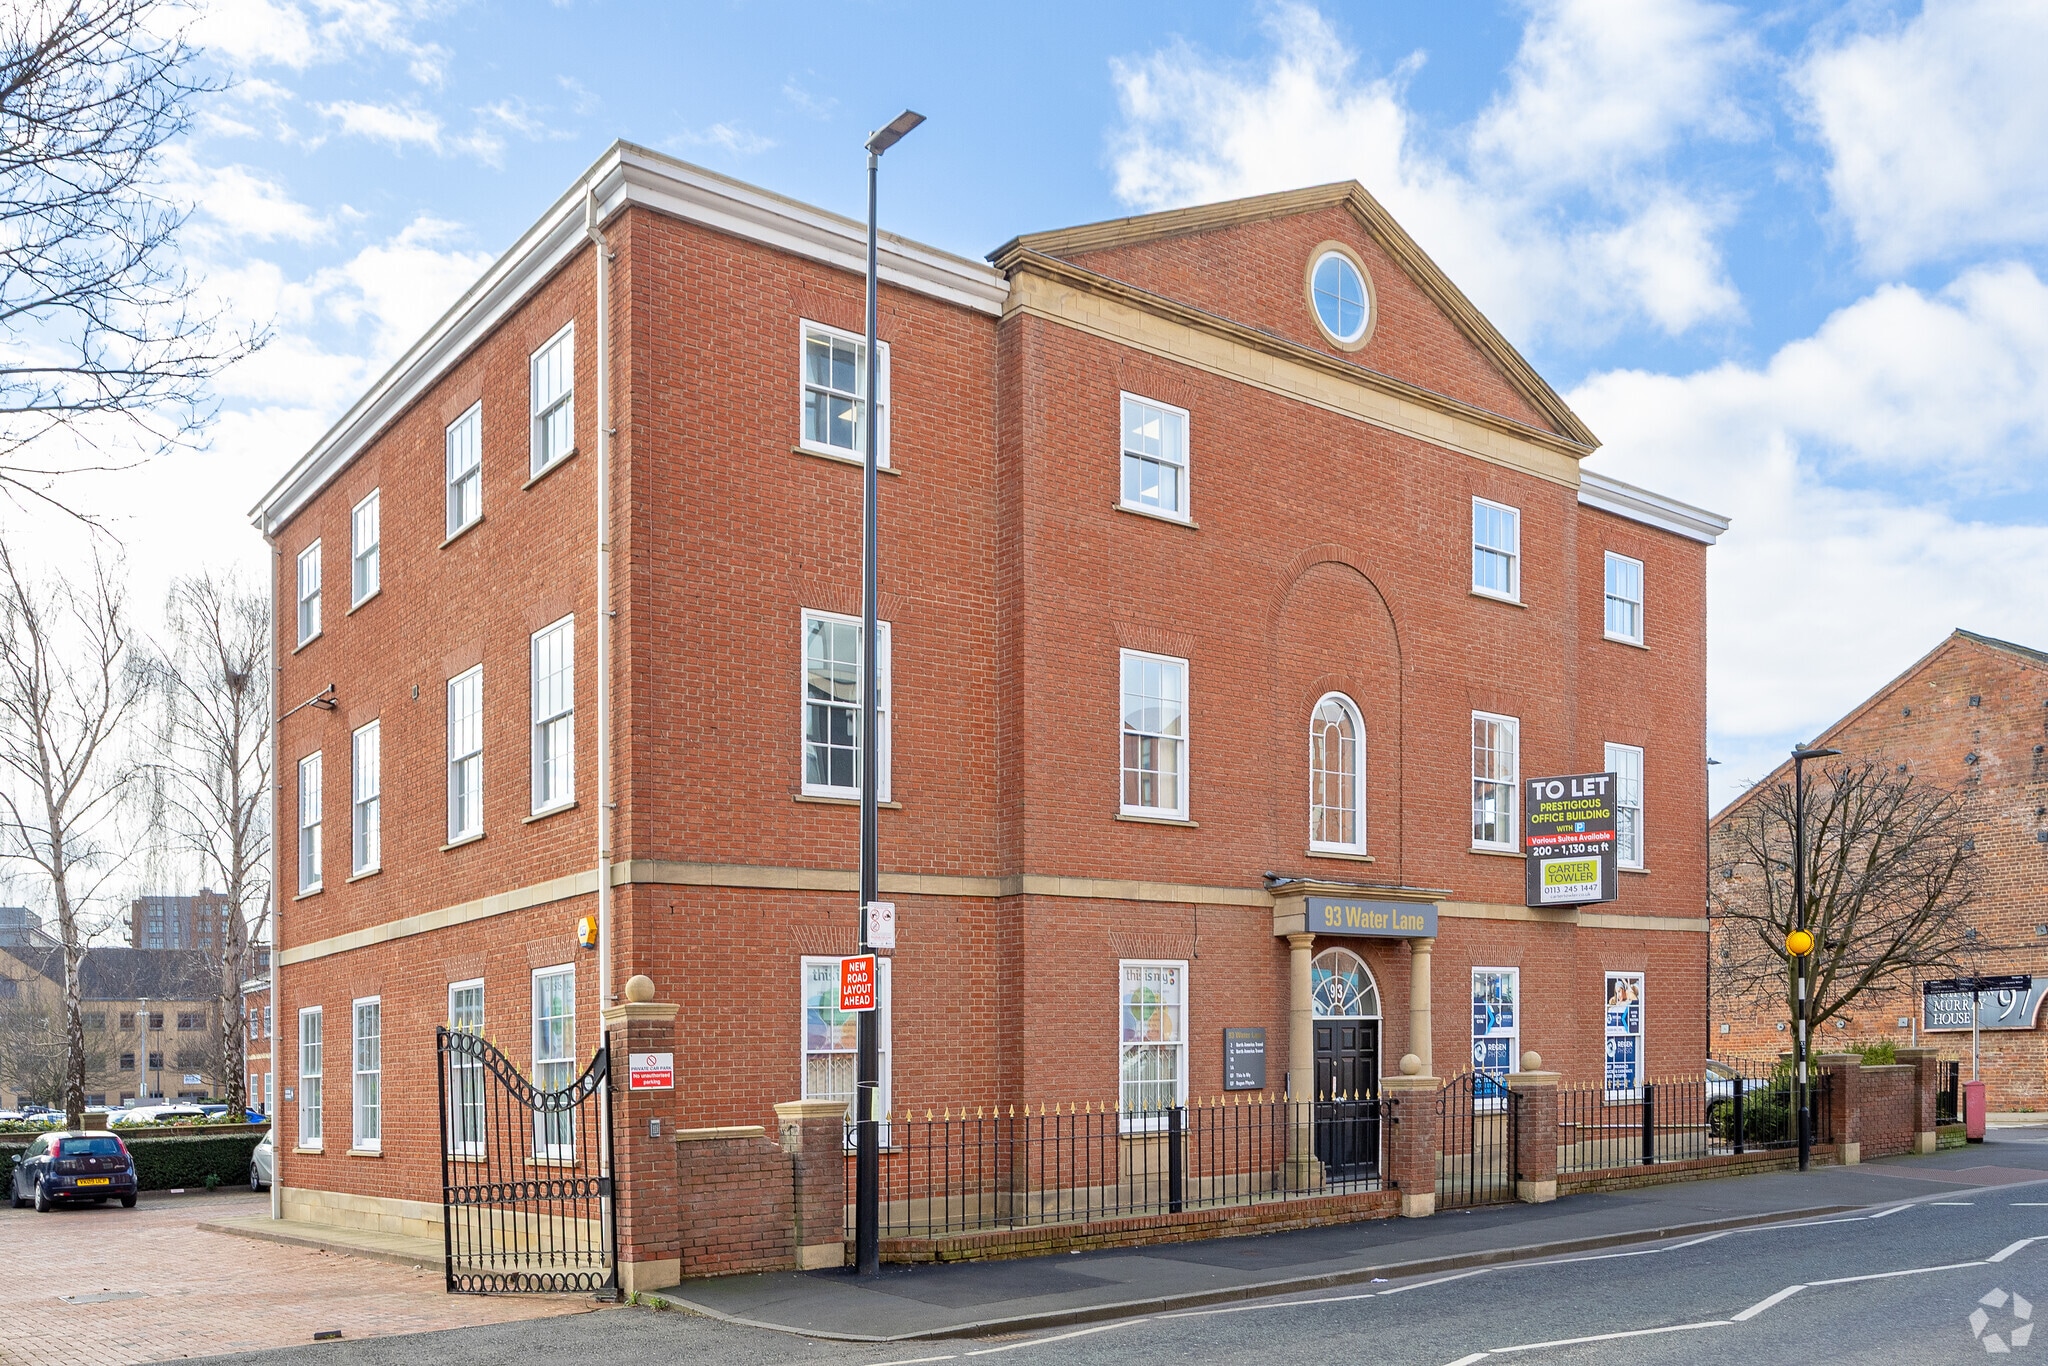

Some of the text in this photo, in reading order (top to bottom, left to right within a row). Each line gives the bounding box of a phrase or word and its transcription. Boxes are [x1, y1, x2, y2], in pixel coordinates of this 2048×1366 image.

[1532, 776, 1609, 800] TO LET
[1540, 798, 1601, 812] PRESTIGIOUS
[1531, 809, 1610, 824] OFFICE BUILDING
[1532, 832, 1610, 844] Various Suites Available
[1533, 846, 1552, 856] 200
[1561, 844, 1585, 855] 1,130
[1587, 845, 1599, 854] sq
[1601, 842, 1609, 851] ft
[1548, 863, 1590, 874] CARTER
[1548, 872, 1593, 883] TOWLER
[1324, 905, 1425, 931] 93 Water Lane
[849, 961, 866, 972] NEW
[847, 972, 868, 984] ROAD
[843, 983, 872, 995] LAYOUT
[1330, 984, 1343, 999] 93
[844, 995, 870, 1006] AHEAD
[1933, 1012, 1971, 1025] HOUSE
